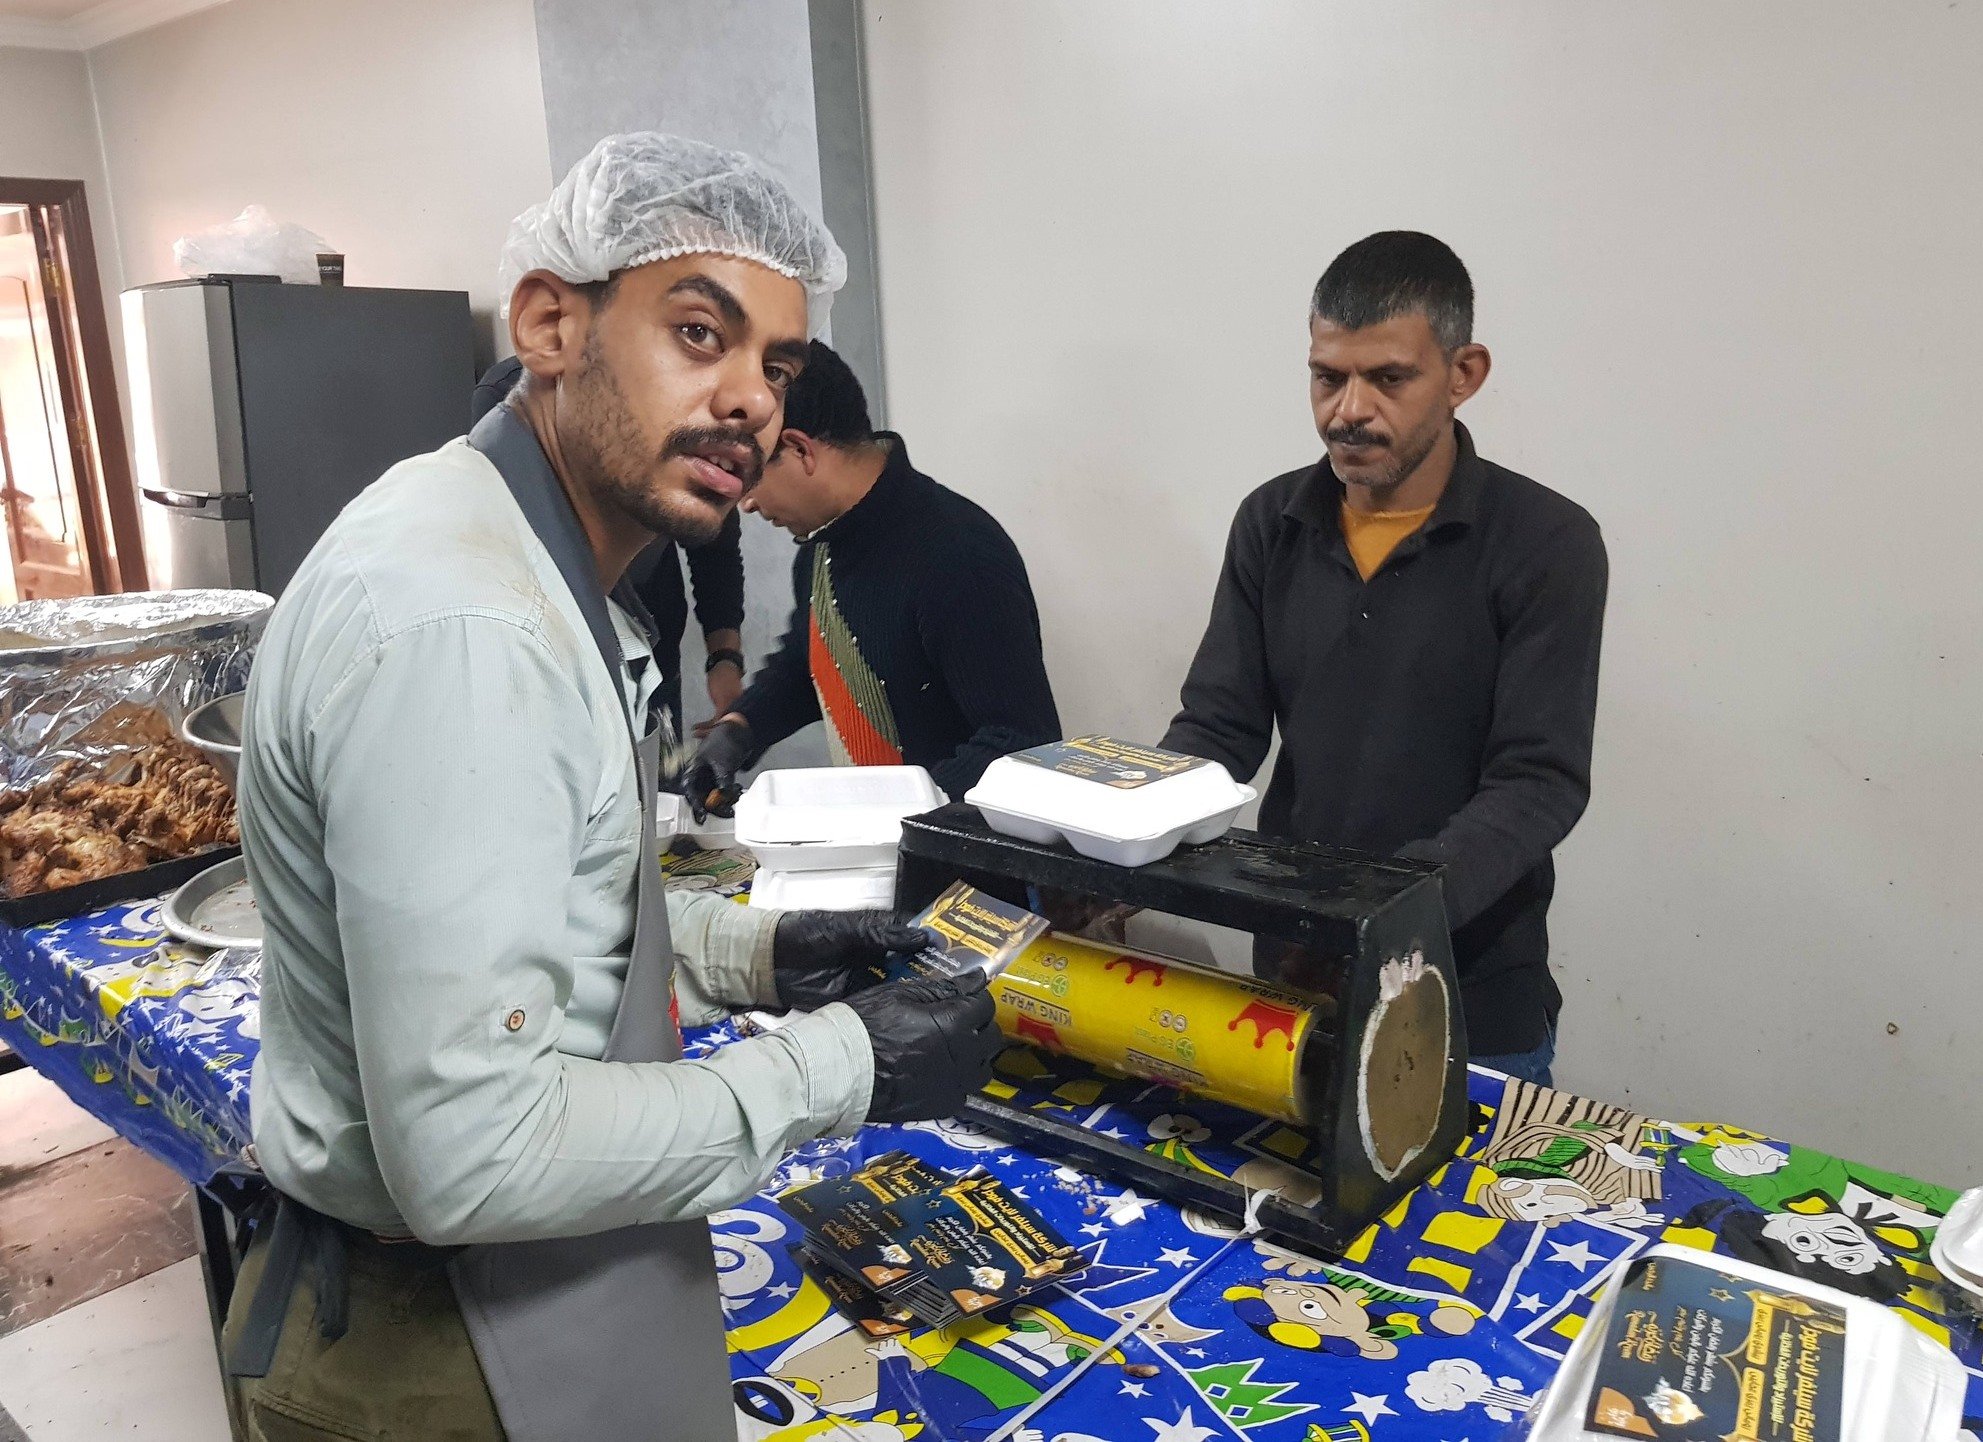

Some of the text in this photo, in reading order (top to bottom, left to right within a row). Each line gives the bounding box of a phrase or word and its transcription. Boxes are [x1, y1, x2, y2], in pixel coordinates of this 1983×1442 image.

[999, 991, 1072, 1027] KING WRAP
[1286, 995, 1318, 1015] ING
[996, 1199, 1018, 1217] لايت
[1008, 1211, 1037, 1236] سيلفر
[1031, 1230, 1058, 1254] شركة
[1799, 1324, 1822, 1350] فودز
[1797, 1349, 1820, 1377] لايت
[1793, 1371, 1818, 1410] سيلفر
